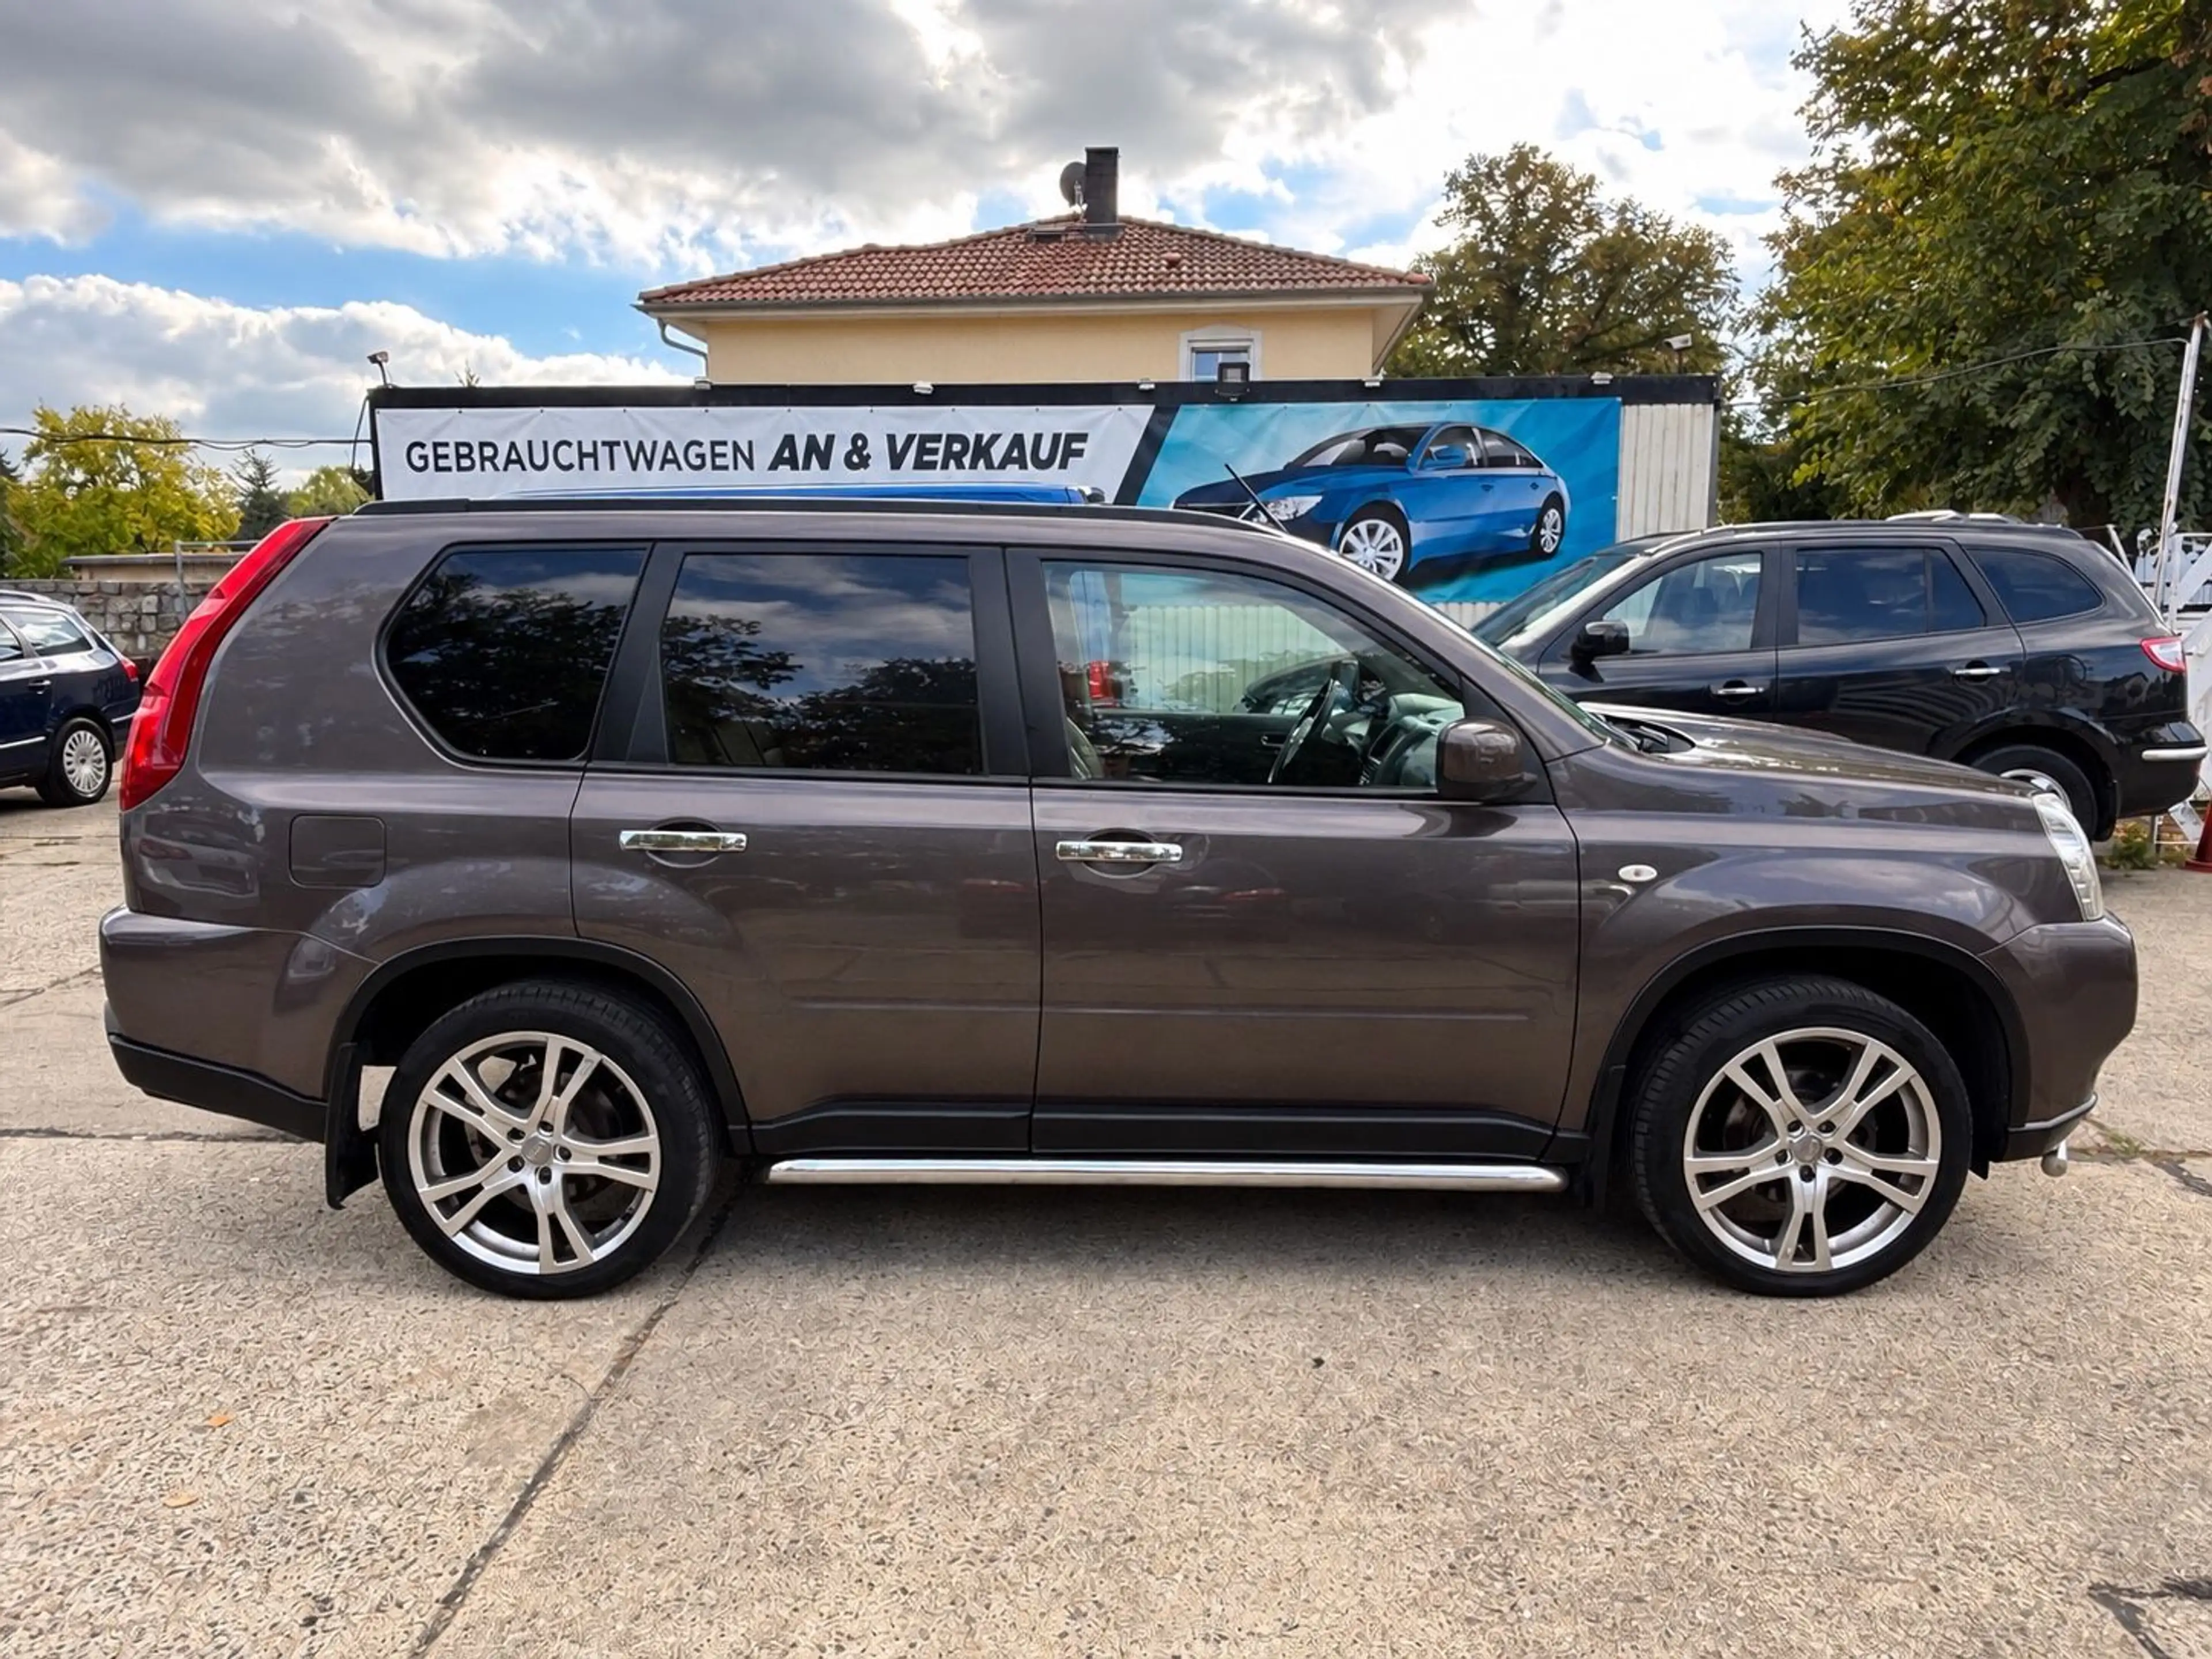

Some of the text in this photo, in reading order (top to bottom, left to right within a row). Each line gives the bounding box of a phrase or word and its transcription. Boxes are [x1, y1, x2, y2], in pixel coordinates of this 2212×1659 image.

[406, 432, 1089, 473] GEBRAUCHTWAGEN AN & VERKAUF
